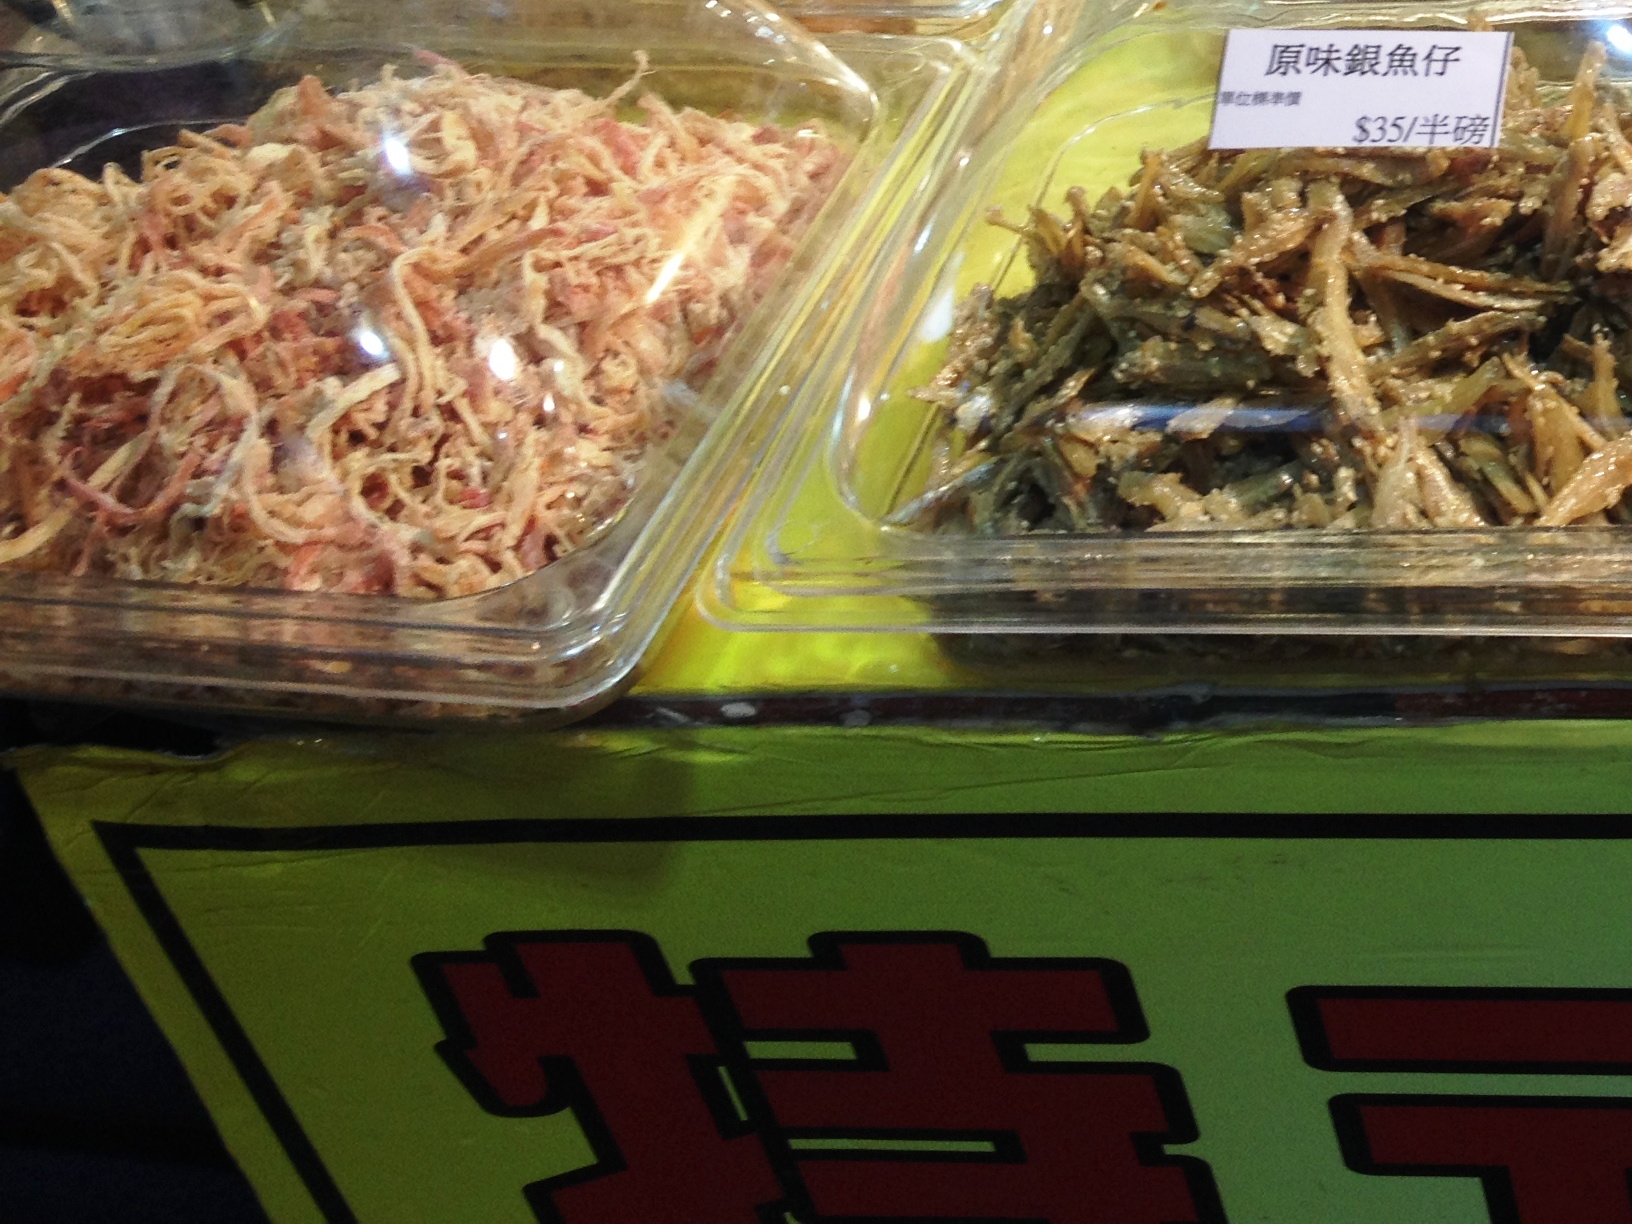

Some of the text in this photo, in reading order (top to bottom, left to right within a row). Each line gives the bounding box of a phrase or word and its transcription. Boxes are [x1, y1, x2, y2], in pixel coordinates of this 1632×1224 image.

[1264, 42, 1463, 78] 原味銀魚仔
[1352, 113, 1491, 146] $35/半磅
